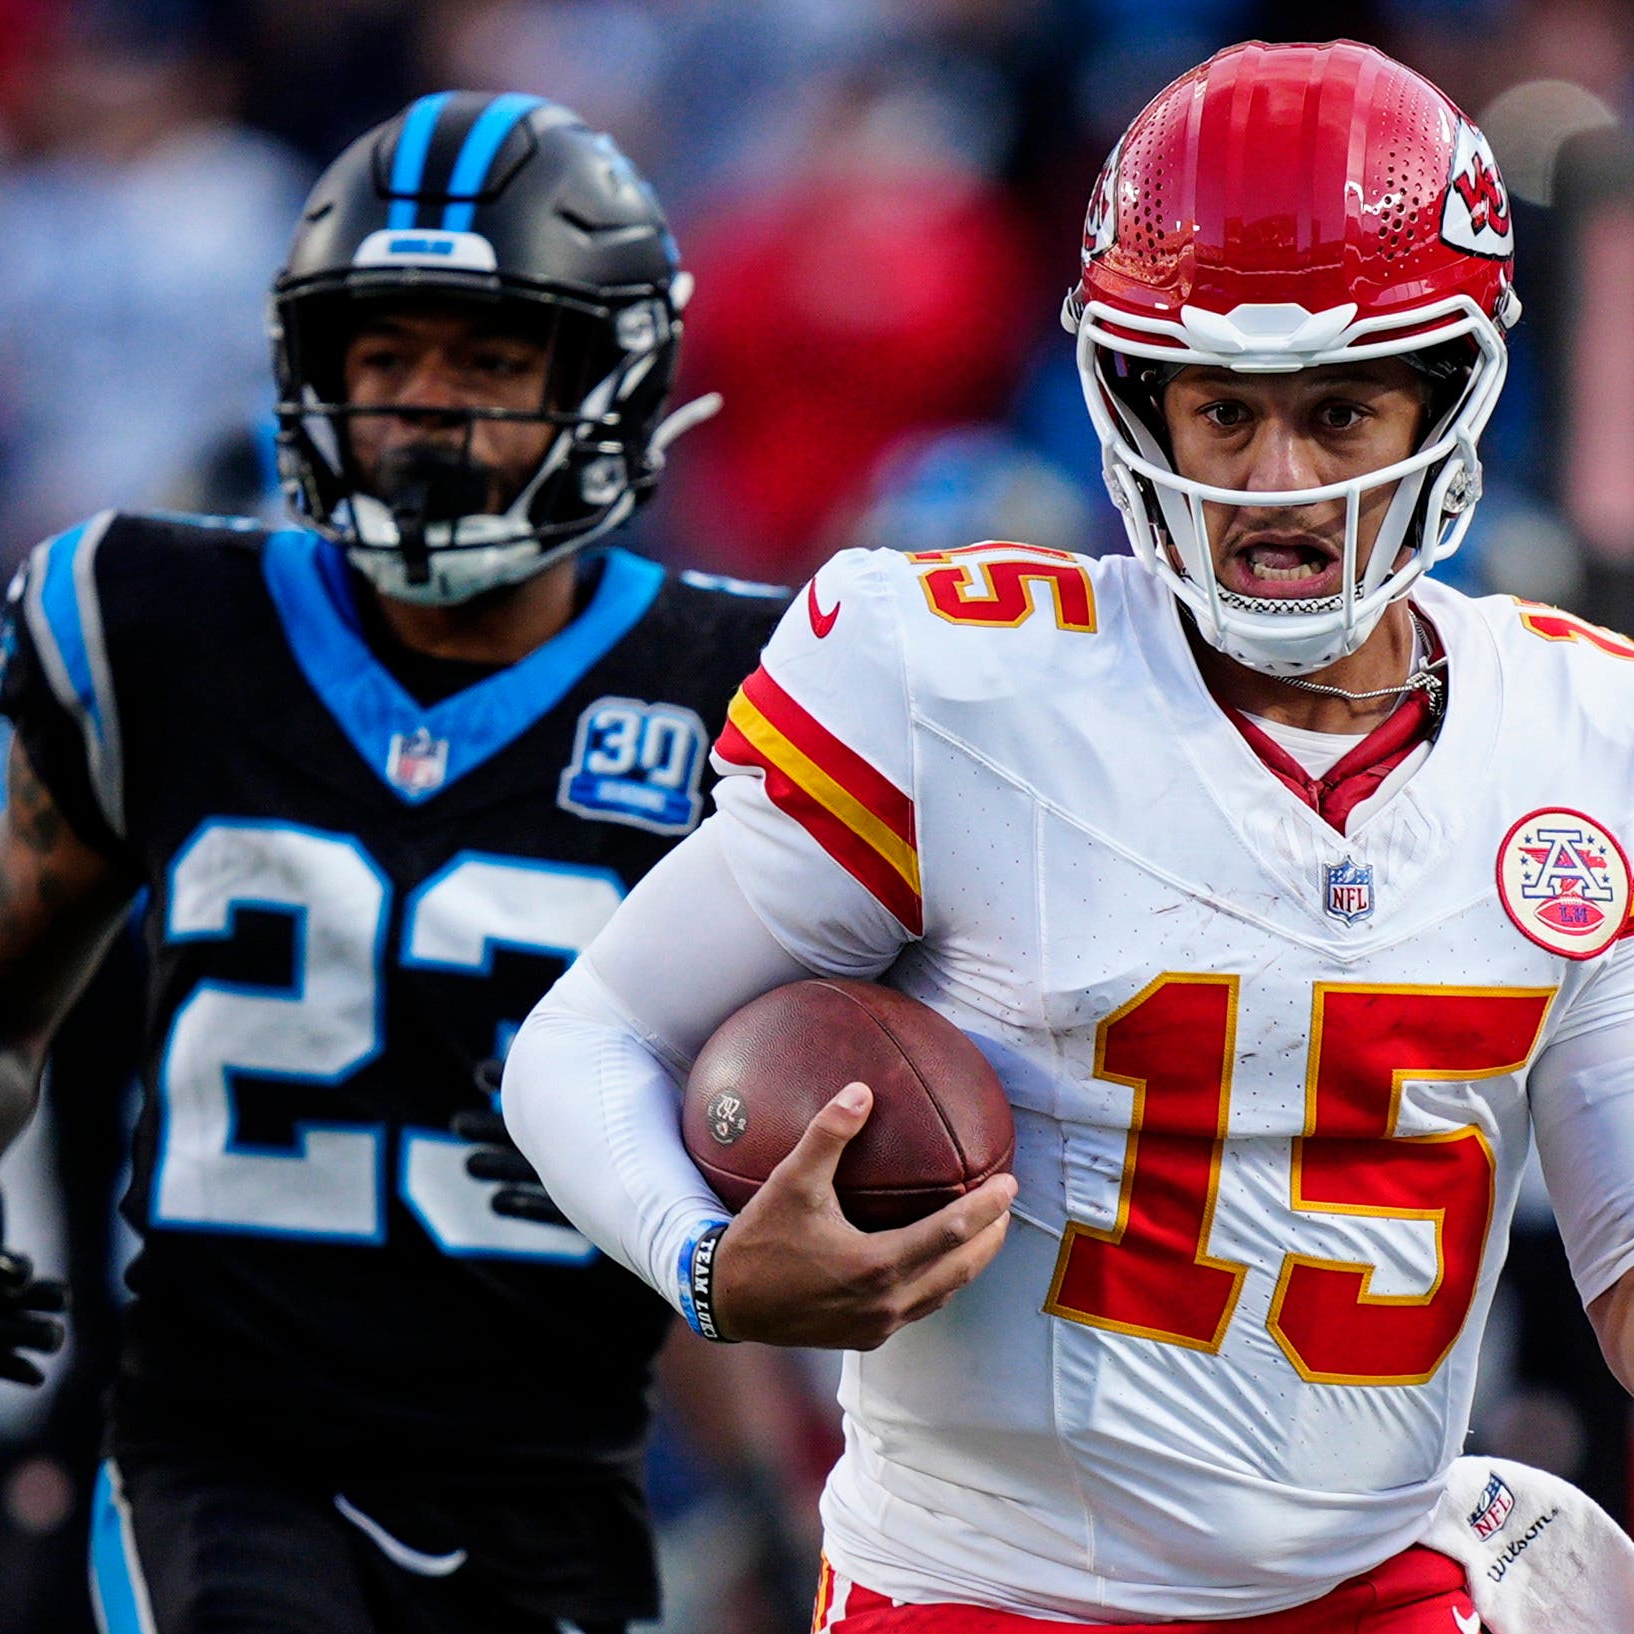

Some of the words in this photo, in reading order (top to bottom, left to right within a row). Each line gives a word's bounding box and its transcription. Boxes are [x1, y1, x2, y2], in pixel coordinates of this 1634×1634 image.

[588, 709, 688, 788] 30
[1521, 829, 1613, 901] A
[1332, 887, 1367, 913] NFL
[1043, 972, 1558, 1386] 15
[695, 1238, 716, 1294] TEAM
[1473, 1494, 1511, 1537] NFL
